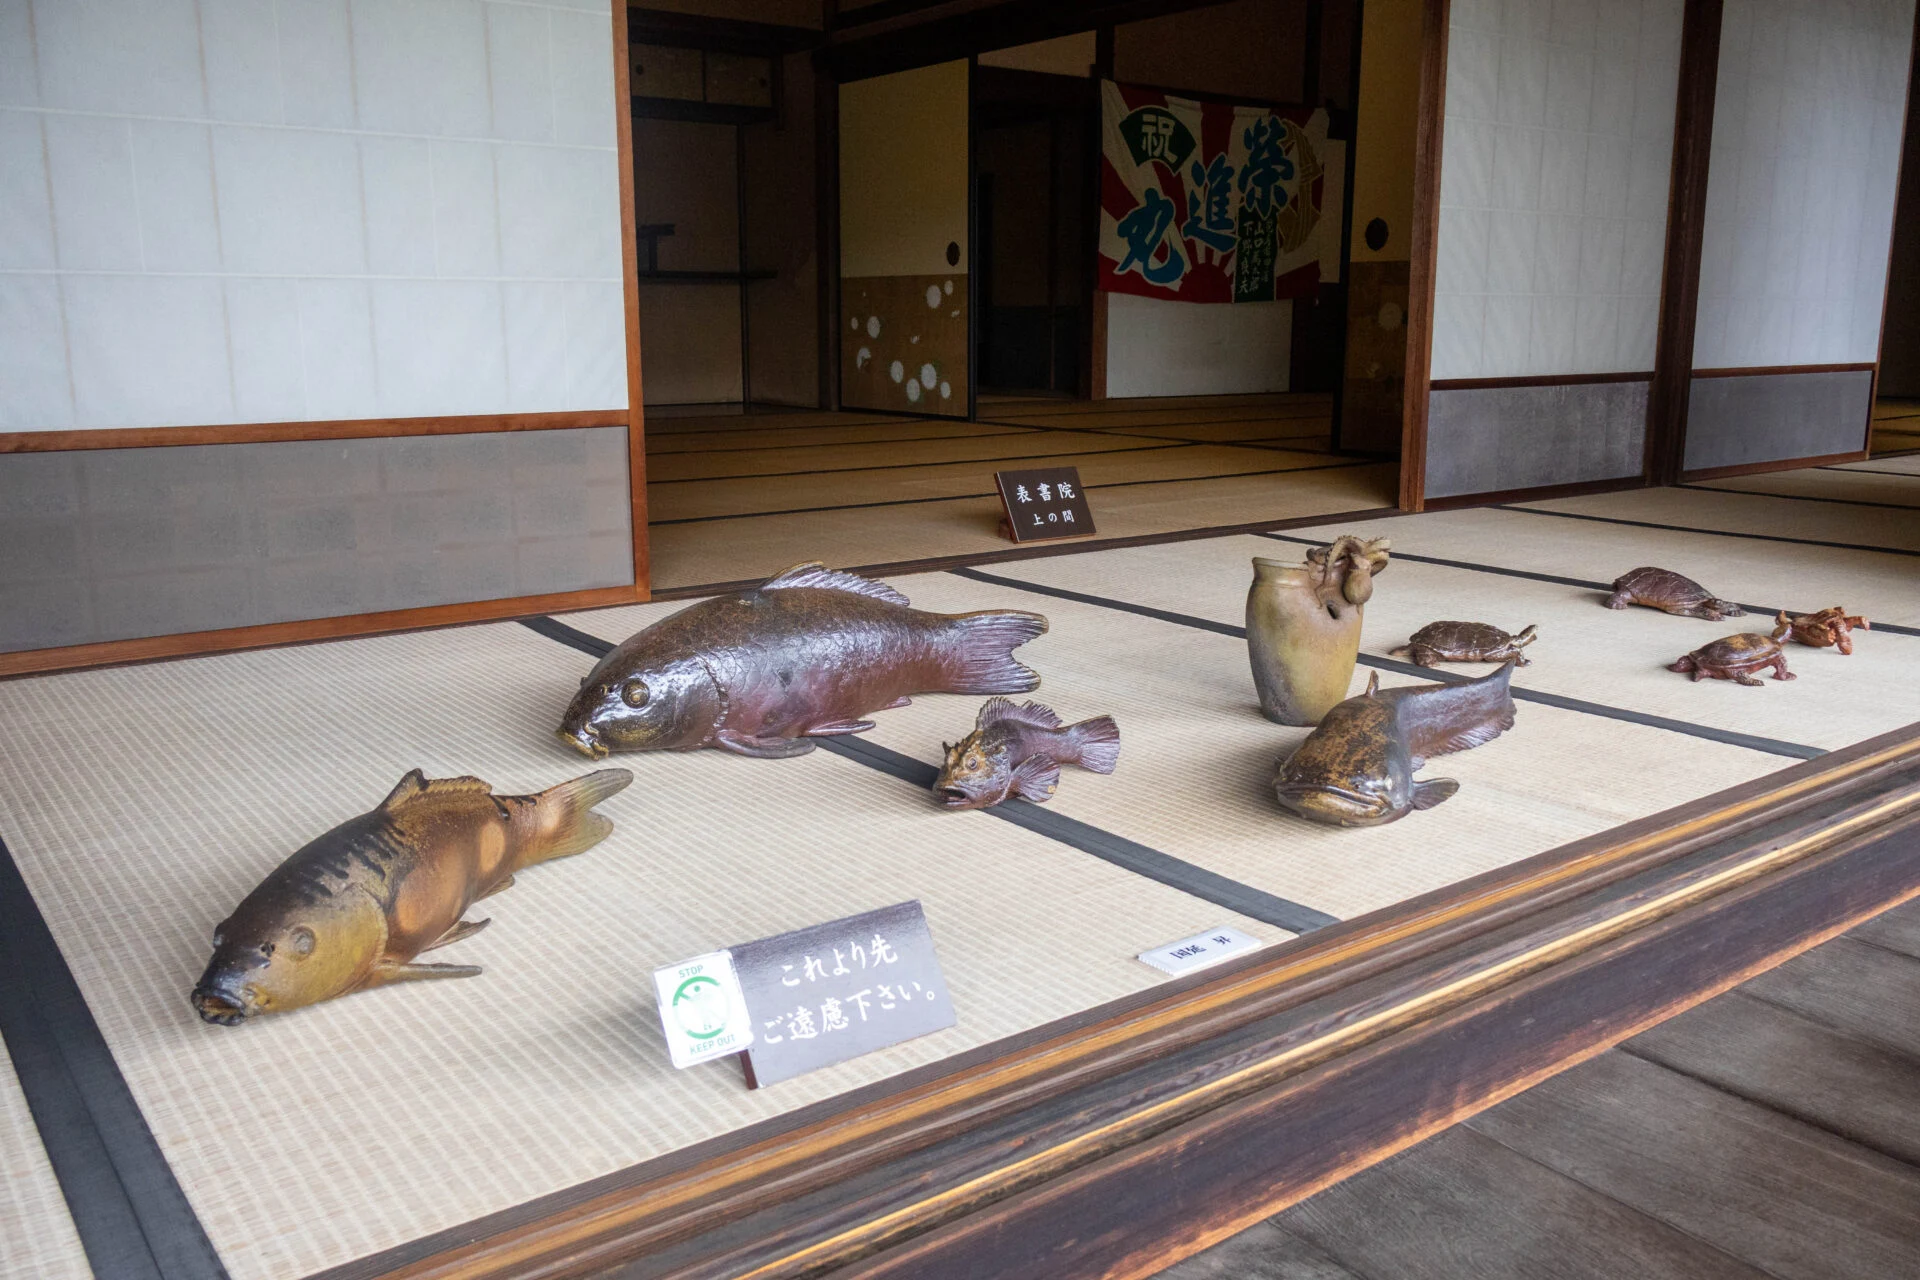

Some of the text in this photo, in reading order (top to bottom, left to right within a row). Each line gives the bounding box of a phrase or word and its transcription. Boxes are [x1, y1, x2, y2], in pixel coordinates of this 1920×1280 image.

[1141, 114, 1178, 163] 祝
[1016, 482, 1076, 503] 表書院
[1033, 509, 1075, 526] 上の間
[781, 934, 898, 987] これより先
[678, 965, 703, 978] STOP
[764, 981, 935, 1044] ご遠慮下さい。
[690, 1034, 736, 1055] KEEP OUT
